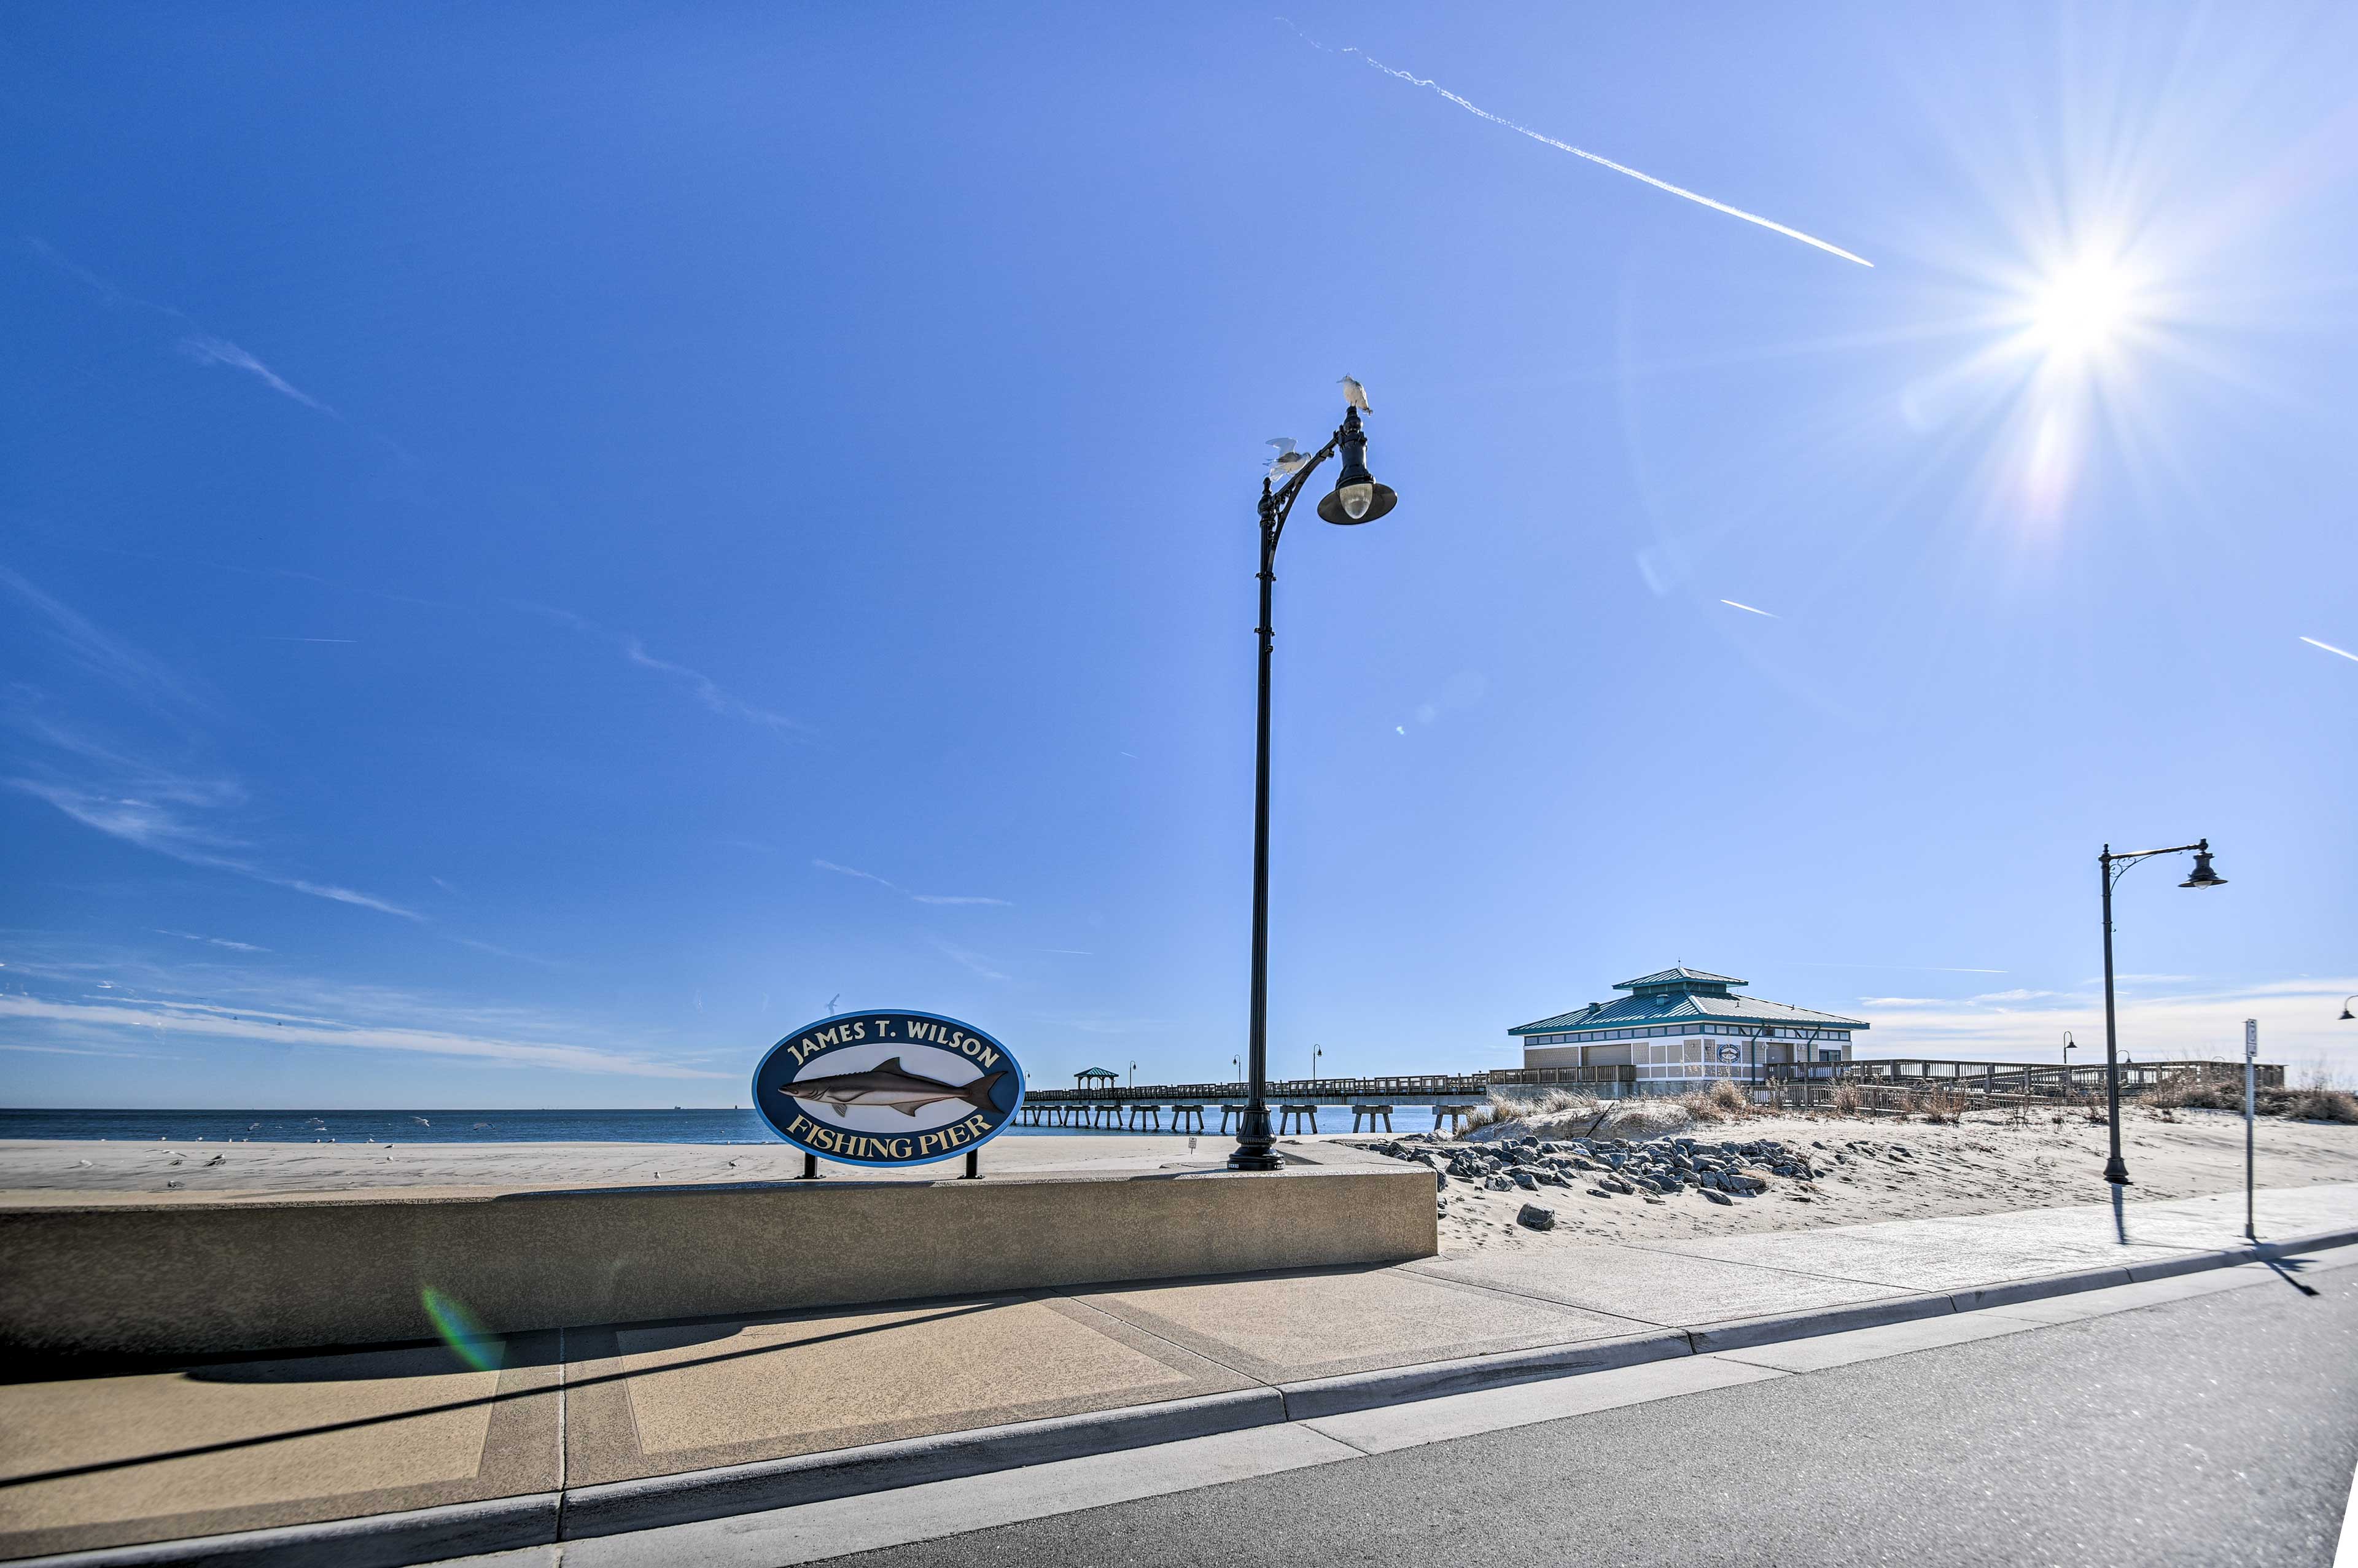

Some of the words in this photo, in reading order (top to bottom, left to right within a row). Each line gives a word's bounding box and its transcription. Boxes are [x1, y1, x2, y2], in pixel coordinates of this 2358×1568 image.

[787, 1022, 865, 1065] JAMES
[875, 1020, 896, 1037] T.
[907, 1020, 1000, 1068] WILSON
[787, 1114, 912, 1159] FISHING
[917, 1114, 992, 1155] PIER
